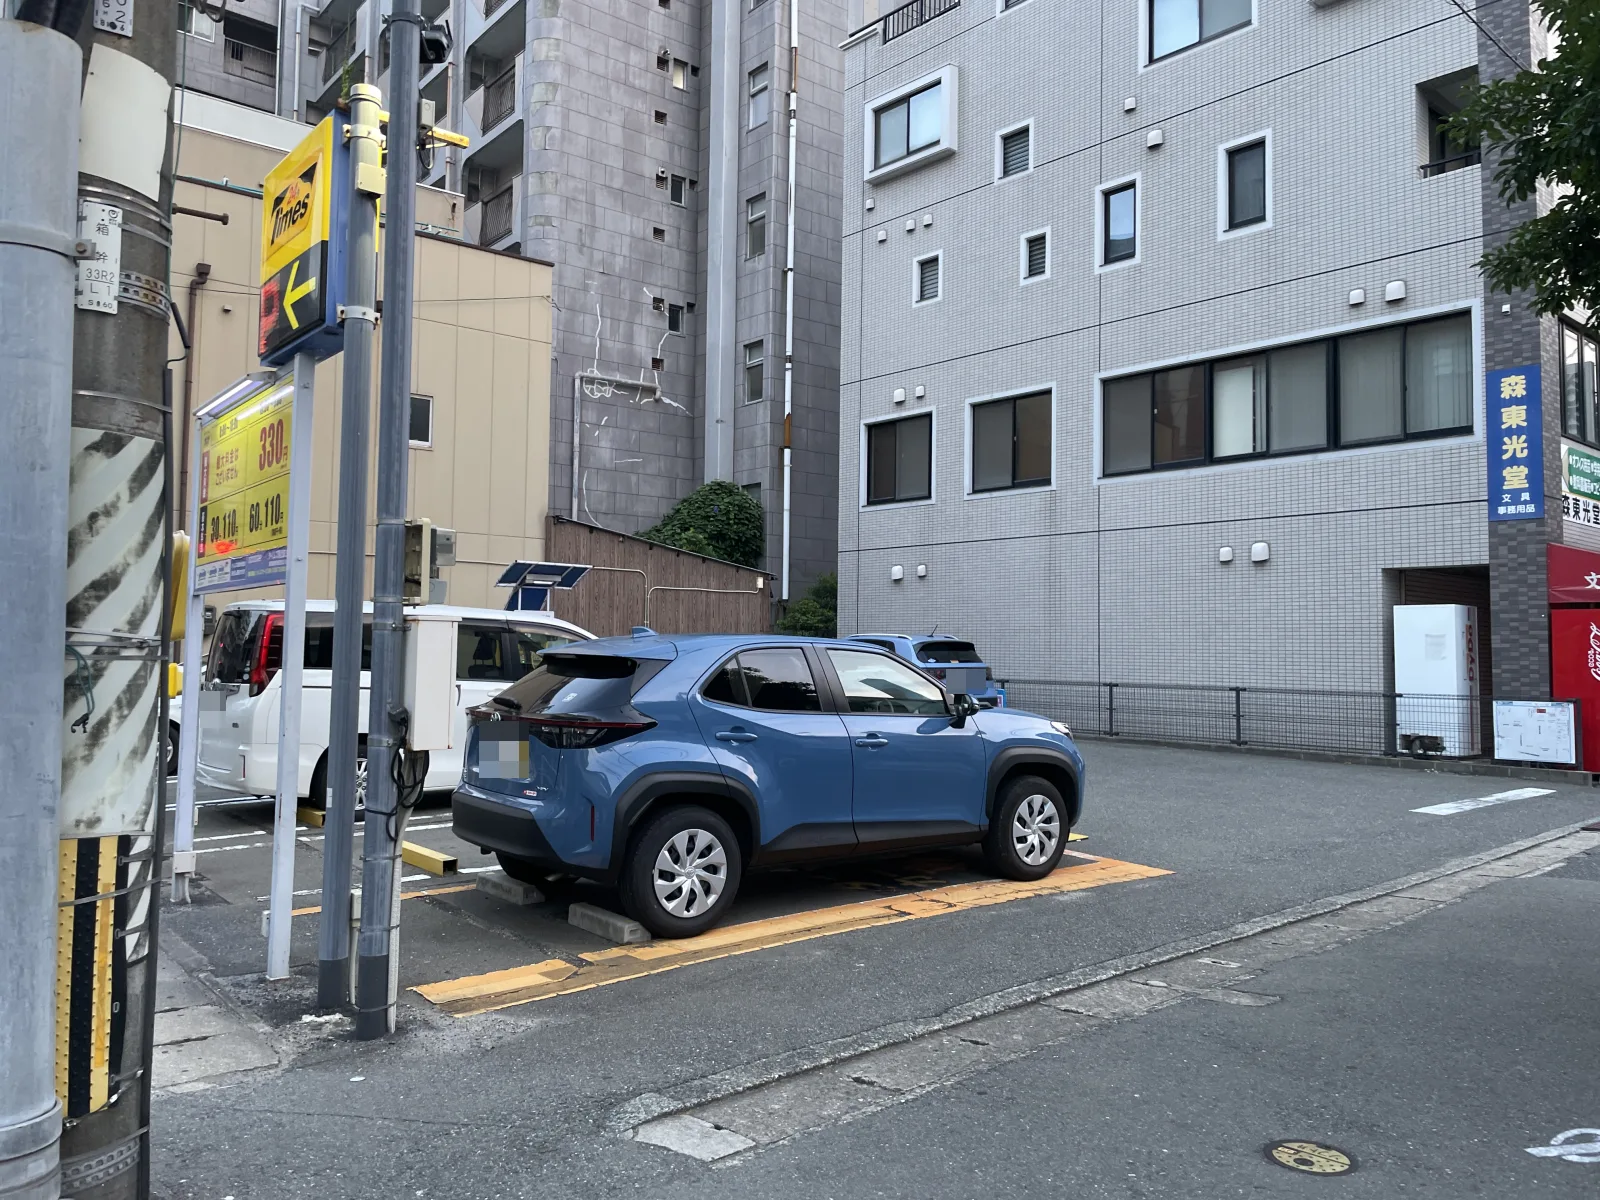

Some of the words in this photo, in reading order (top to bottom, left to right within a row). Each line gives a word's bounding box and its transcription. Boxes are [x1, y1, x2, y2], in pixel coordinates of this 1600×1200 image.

[270, 192, 310, 247] Times
[86, 267, 115, 284] 33R2
[1500, 375, 1528, 489] 森東光堂
